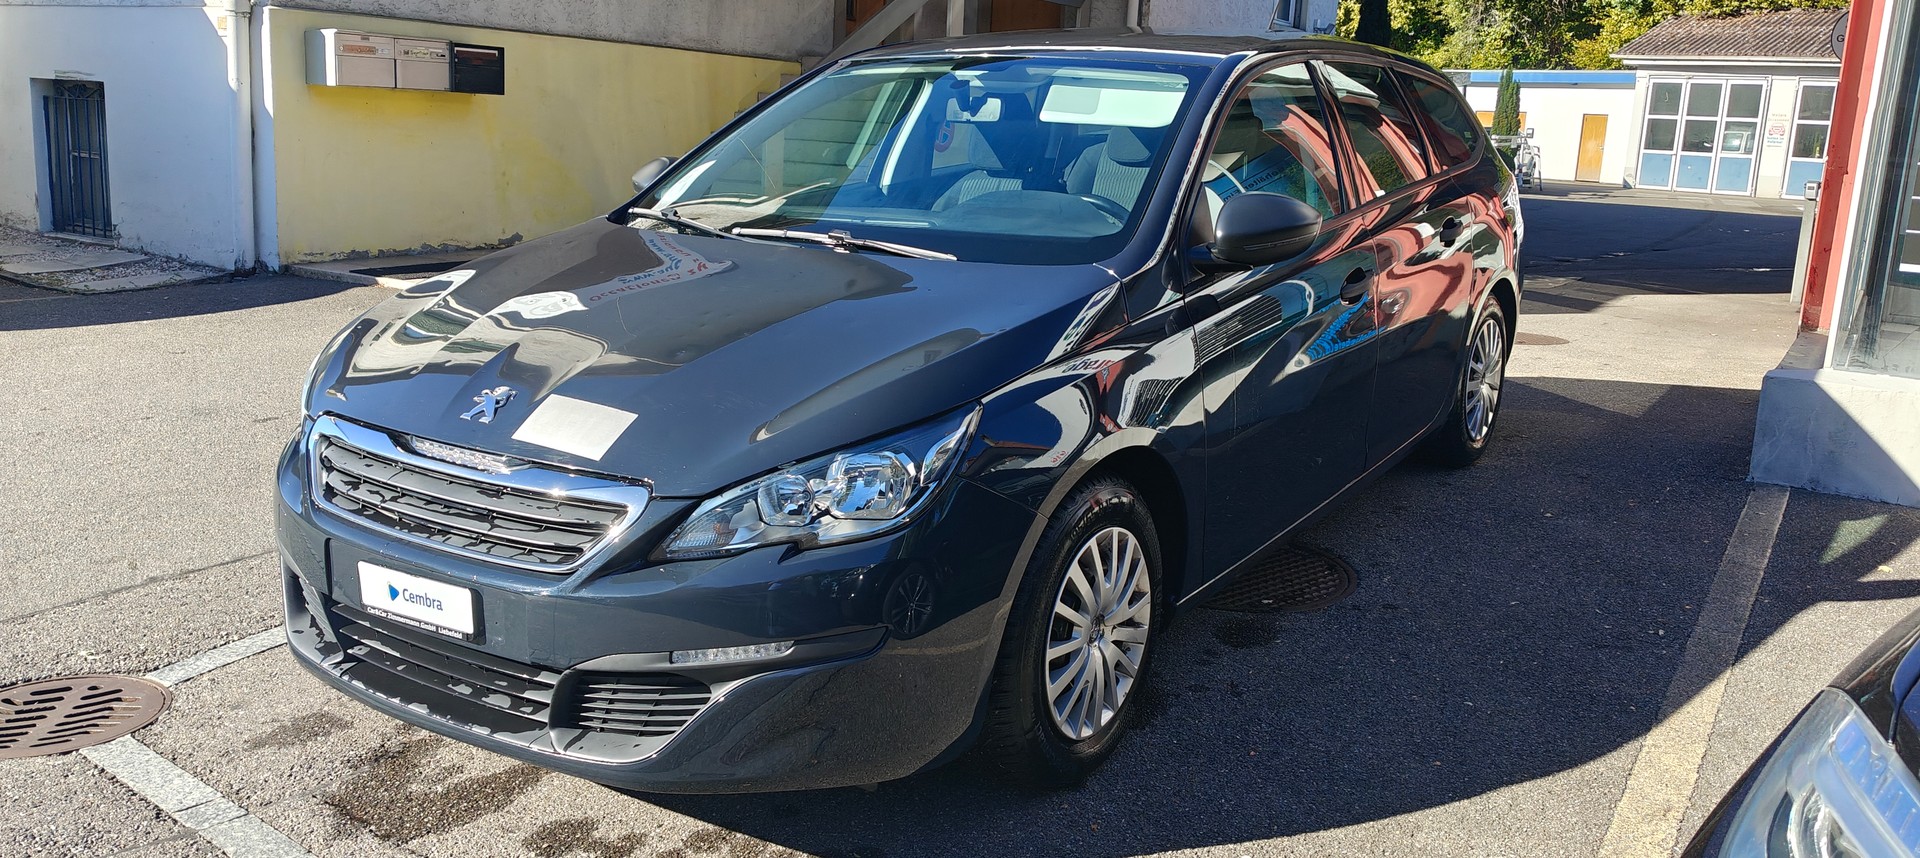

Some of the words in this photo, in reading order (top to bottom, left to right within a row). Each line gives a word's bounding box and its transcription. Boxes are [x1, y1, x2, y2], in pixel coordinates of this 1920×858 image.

[402, 588, 444, 611] Cembra
[387, 612, 420, 627] Zimmermann
[420, 622, 437, 632] GmbH
[438, 626, 463, 639] Liebefeld
